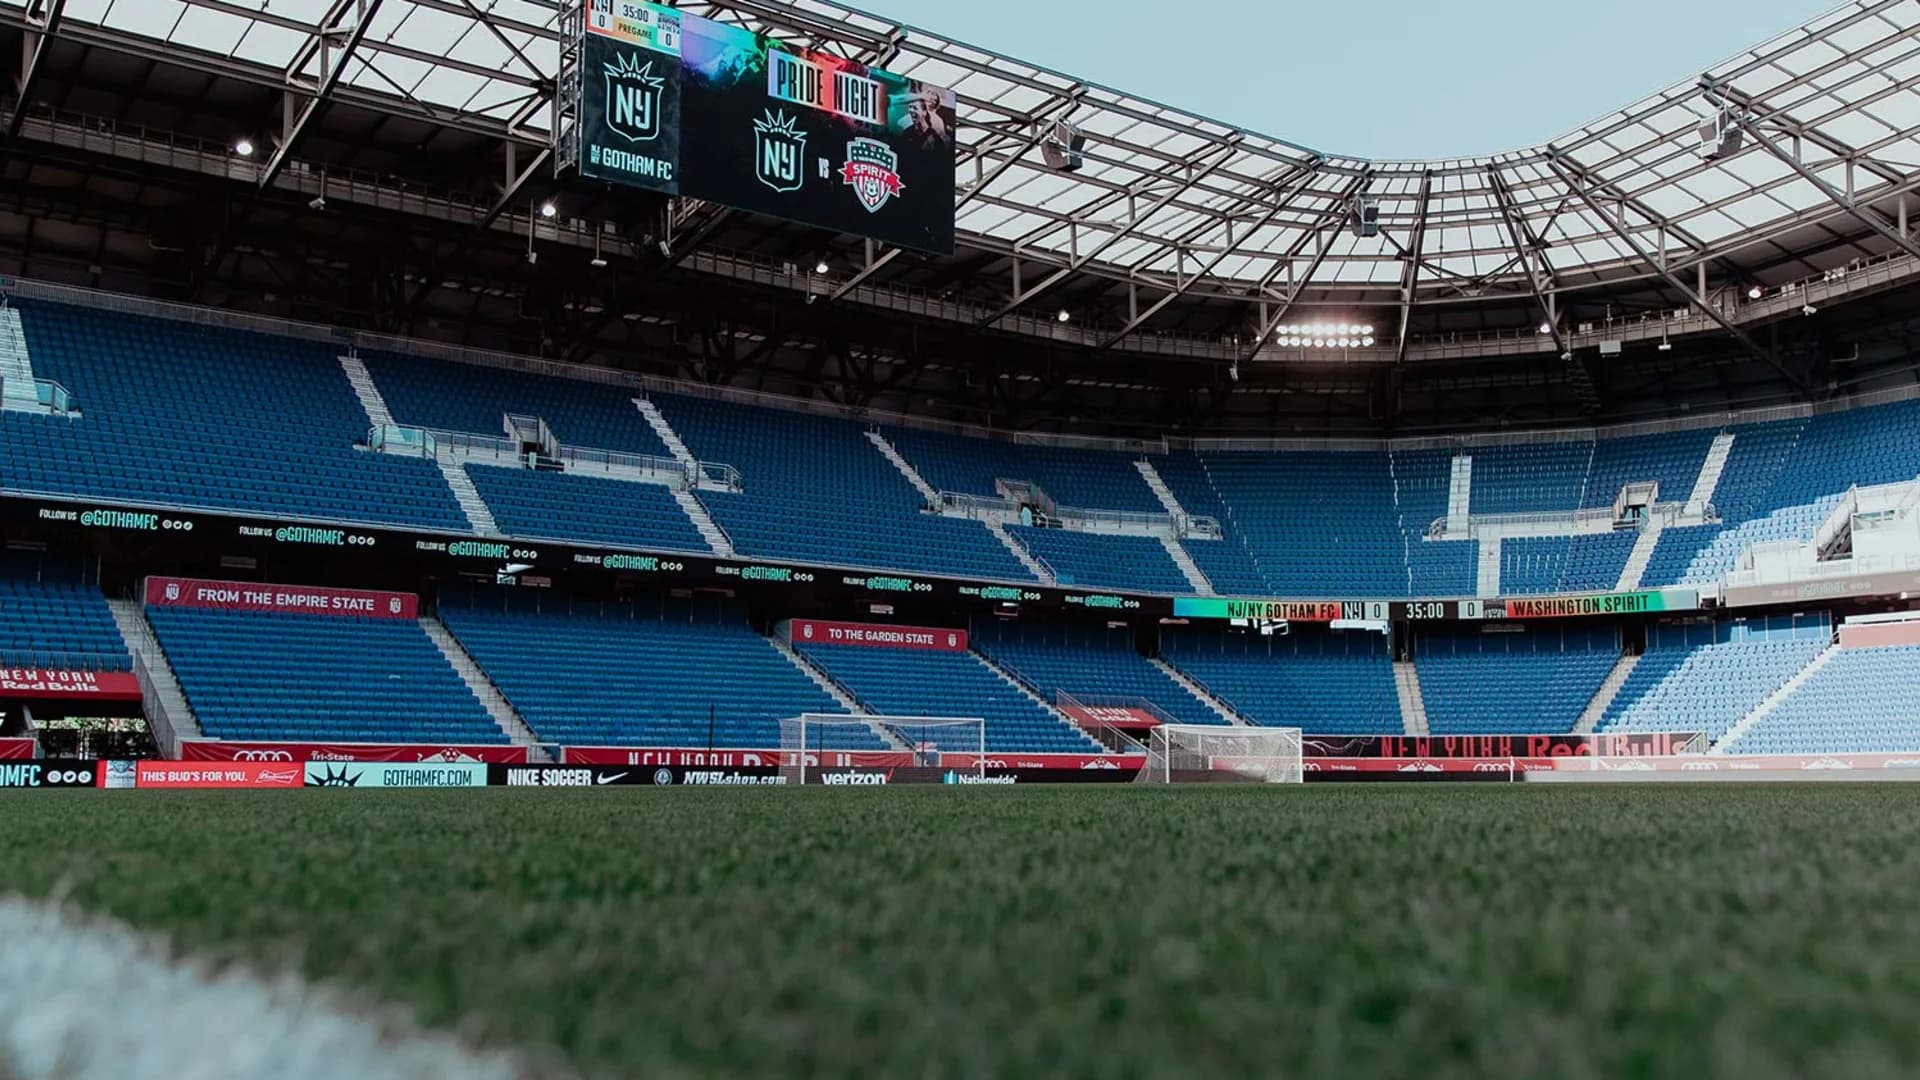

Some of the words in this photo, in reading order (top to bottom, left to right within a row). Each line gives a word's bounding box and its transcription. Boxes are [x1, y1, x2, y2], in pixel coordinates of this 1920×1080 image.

[598, 15, 605, 27] 0
[623, 5, 649, 22] 35:00
[618, 22, 652, 40] PREGAME
[665, 33, 671, 46] 0
[777, 58, 824, 105] PRIDE
[834, 73, 879, 119] NIGHT
[616, 84, 652, 129] NY
[603, 147, 655, 176] GOTHAM
[657, 160, 672, 180] FC
[764, 138, 796, 181] NY
[853, 164, 891, 182] SPIRIT
[39, 509, 67, 520] FOLLOW
[80, 509, 159, 530] @GOTHAMFC
[276, 527, 345, 545] @GOTHAMFC
[448, 541, 511, 559] @GOTHAMFC
[603, 555, 658, 571] @GOTHAMFC
[742, 566, 791, 582] @GOTHAMFC
[197, 588, 239, 603] FROM
[243, 591, 272, 605] THE
[276, 593, 328, 608] EMPIRE
[332, 597, 374, 611] STATE
[1513, 598, 1601, 616] WASHINGTON
[1604, 595, 1648, 612] SPIRIT
[1228, 602, 1263, 618] NJ/NY
[1266, 602, 1316, 618] GOTHAM
[1320, 604, 1335, 619] FC
[1374, 603, 1381, 618] 0
[1406, 602, 1444, 619] 35:00
[1468, 602, 1475, 617] 0
[829, 628, 842, 639] TO
[844, 630, 863, 640] THE
[865, 631, 904, 643] GARDEN
[906, 634, 934, 644] STATE
[0, 669, 38, 681] NEW
[46, 671, 96, 683] YORK
[2, 681, 45, 690] Red
[48, 683, 101, 691] Bulls
[1528, 735, 1598, 757] Red
[311, 750, 354, 761] Tri-State
[142, 771, 166, 782] THIS
[168, 771, 200, 782] BUD'S
[202, 771, 223, 782] FOR
[225, 771, 248, 782] YOU.
[383, 769, 472, 786] GOTHAMFC.COM
[507, 768, 539, 786] NIKE
[542, 768, 592, 786] SOCCER
[822, 769, 885, 784] verizon
